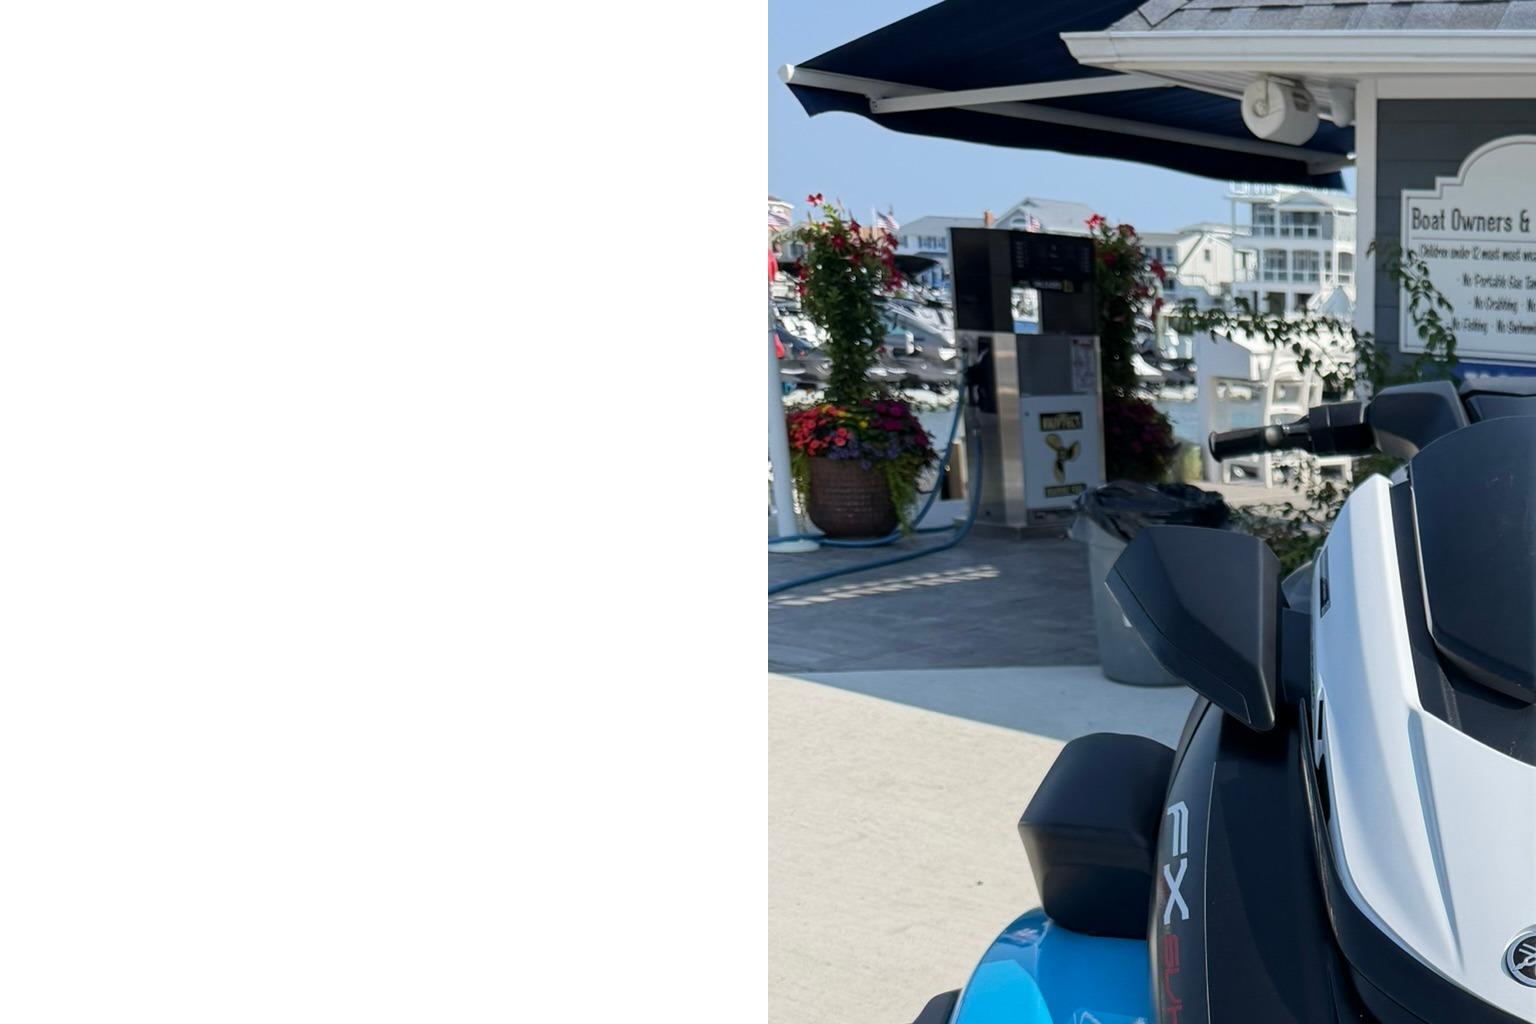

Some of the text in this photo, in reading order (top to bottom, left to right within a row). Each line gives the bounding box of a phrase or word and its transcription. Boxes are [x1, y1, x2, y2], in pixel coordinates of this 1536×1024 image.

[1412, 207, 1445, 231] Boat
[1451, 208, 1512, 233] Owners
[1519, 209, 1530, 233] &
[1163, 800, 1190, 925] FX
